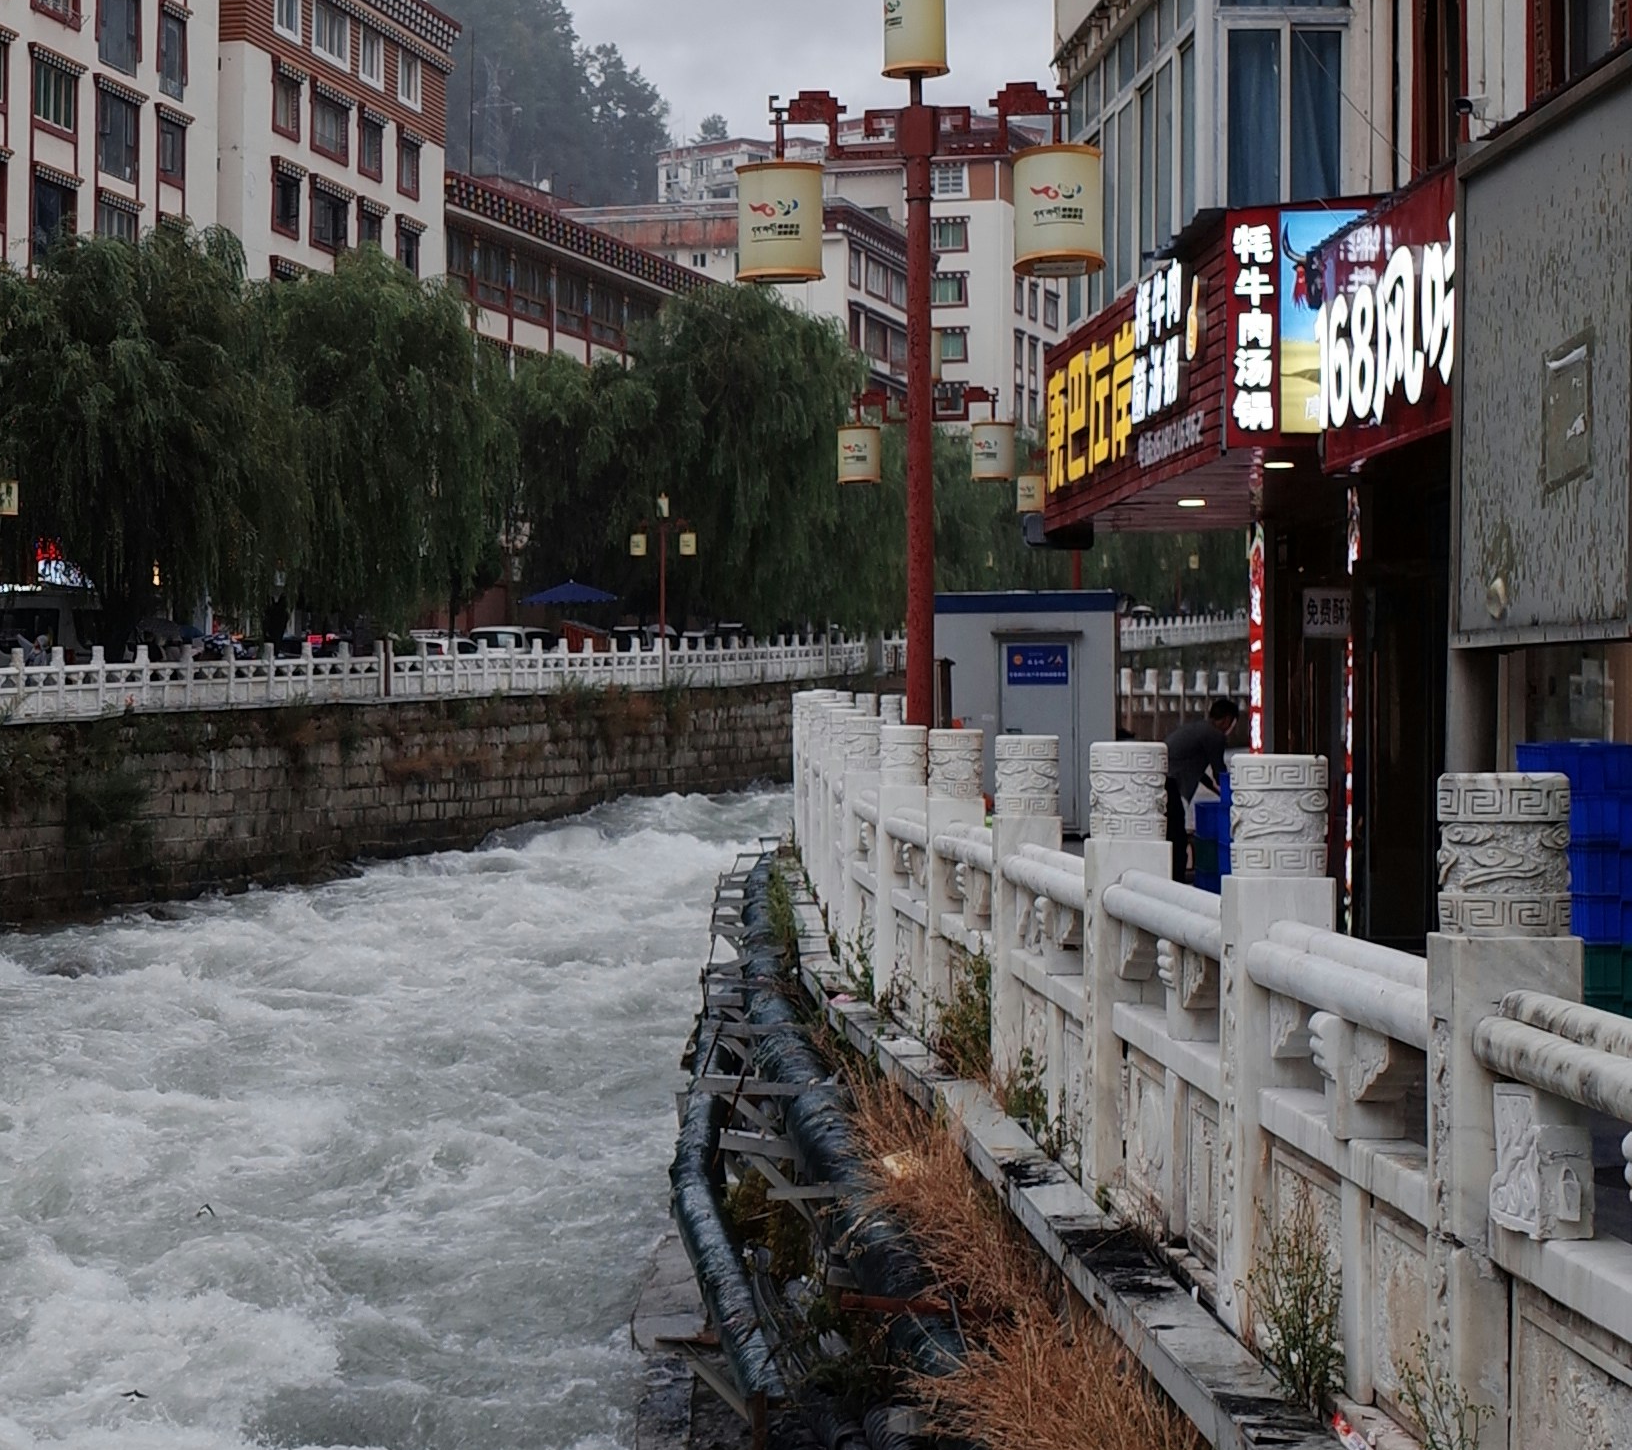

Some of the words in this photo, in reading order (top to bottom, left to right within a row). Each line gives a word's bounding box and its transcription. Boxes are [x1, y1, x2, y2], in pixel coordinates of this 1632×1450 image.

[1135, 258, 1181, 349] 牦牛肉
[1233, 224, 1274, 430] 牦牛肉汤锅
[1048, 321, 1136, 493] 康巴左岸
